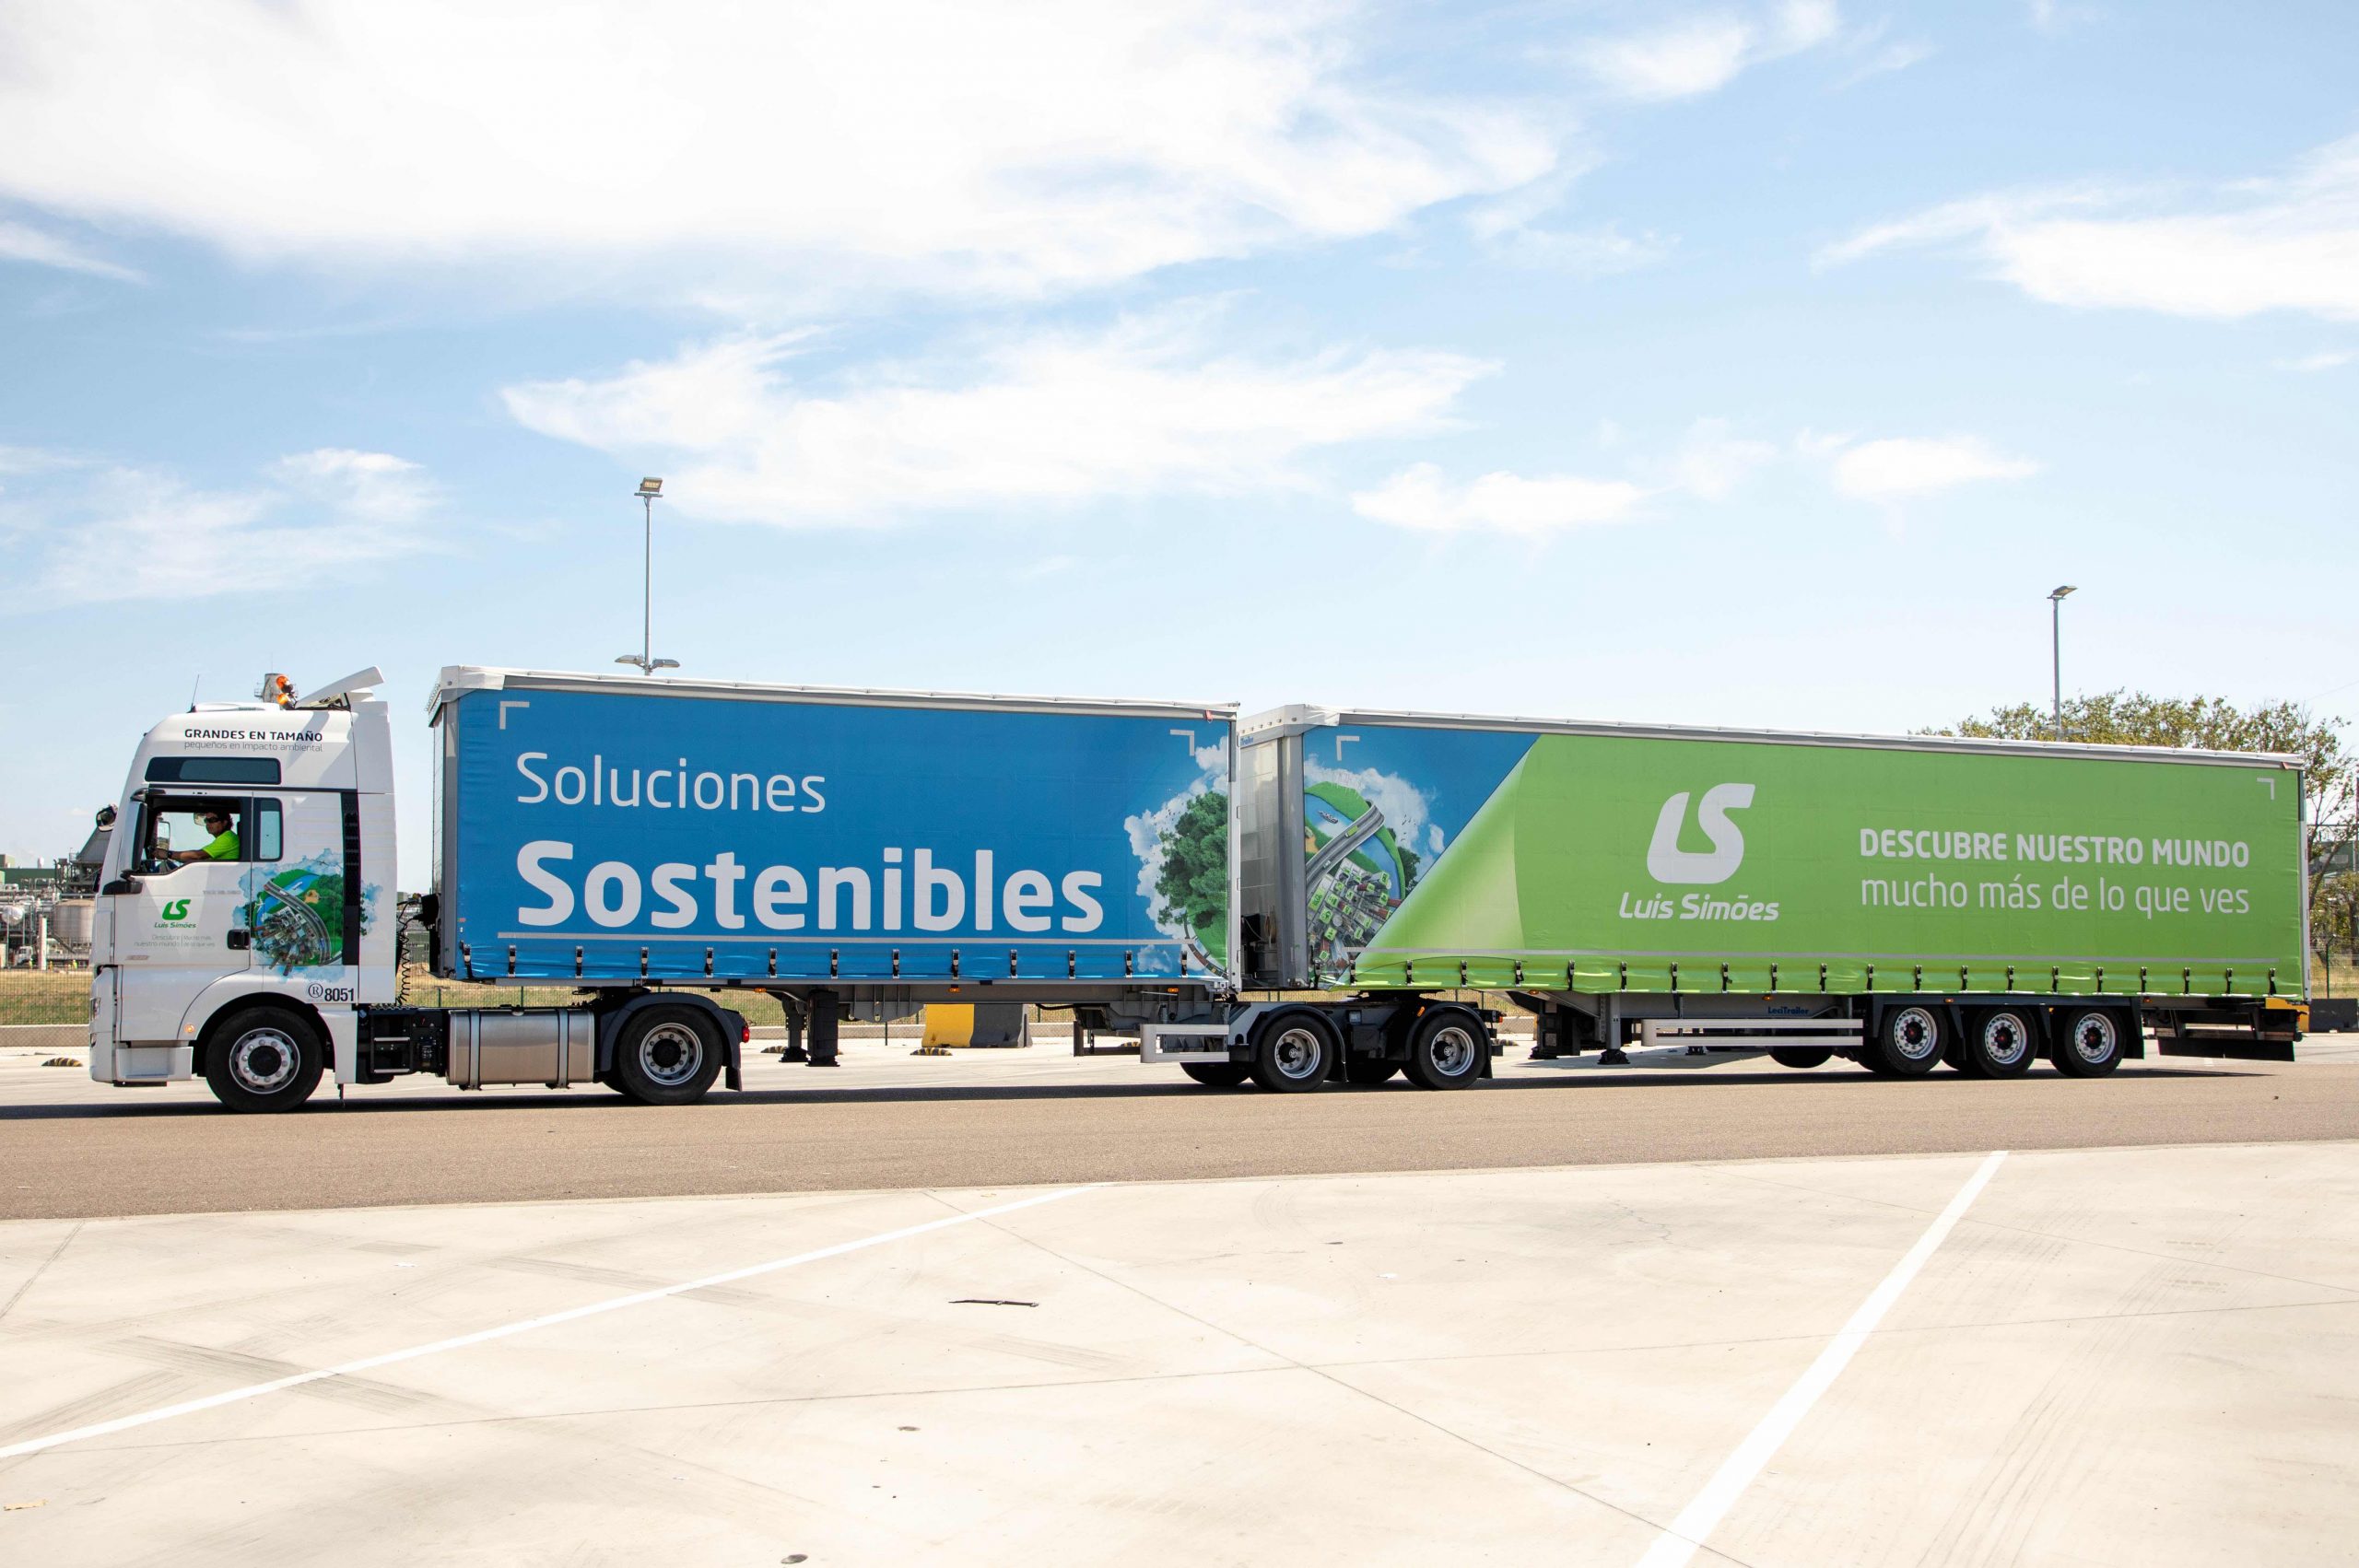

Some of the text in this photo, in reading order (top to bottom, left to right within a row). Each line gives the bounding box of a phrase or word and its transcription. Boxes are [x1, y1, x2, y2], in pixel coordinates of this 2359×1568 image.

[184, 729, 323, 742] GRANDES EN TAMAÑO
[184, 741, 228, 750] pequeños
[242, 742, 277, 751] impacto
[280, 743, 323, 752] ambiental
[516, 752, 826, 813] Soluciones
[1860, 828, 2249, 869] DESCUBRE NUESTRO MUNDO
[516, 840, 1104, 933] Sostenibles
[1861, 872, 2249, 919] mucho más de lo que ves
[1619, 892, 1779, 921] Luis Simões
[324, 988, 355, 1001] 8051
